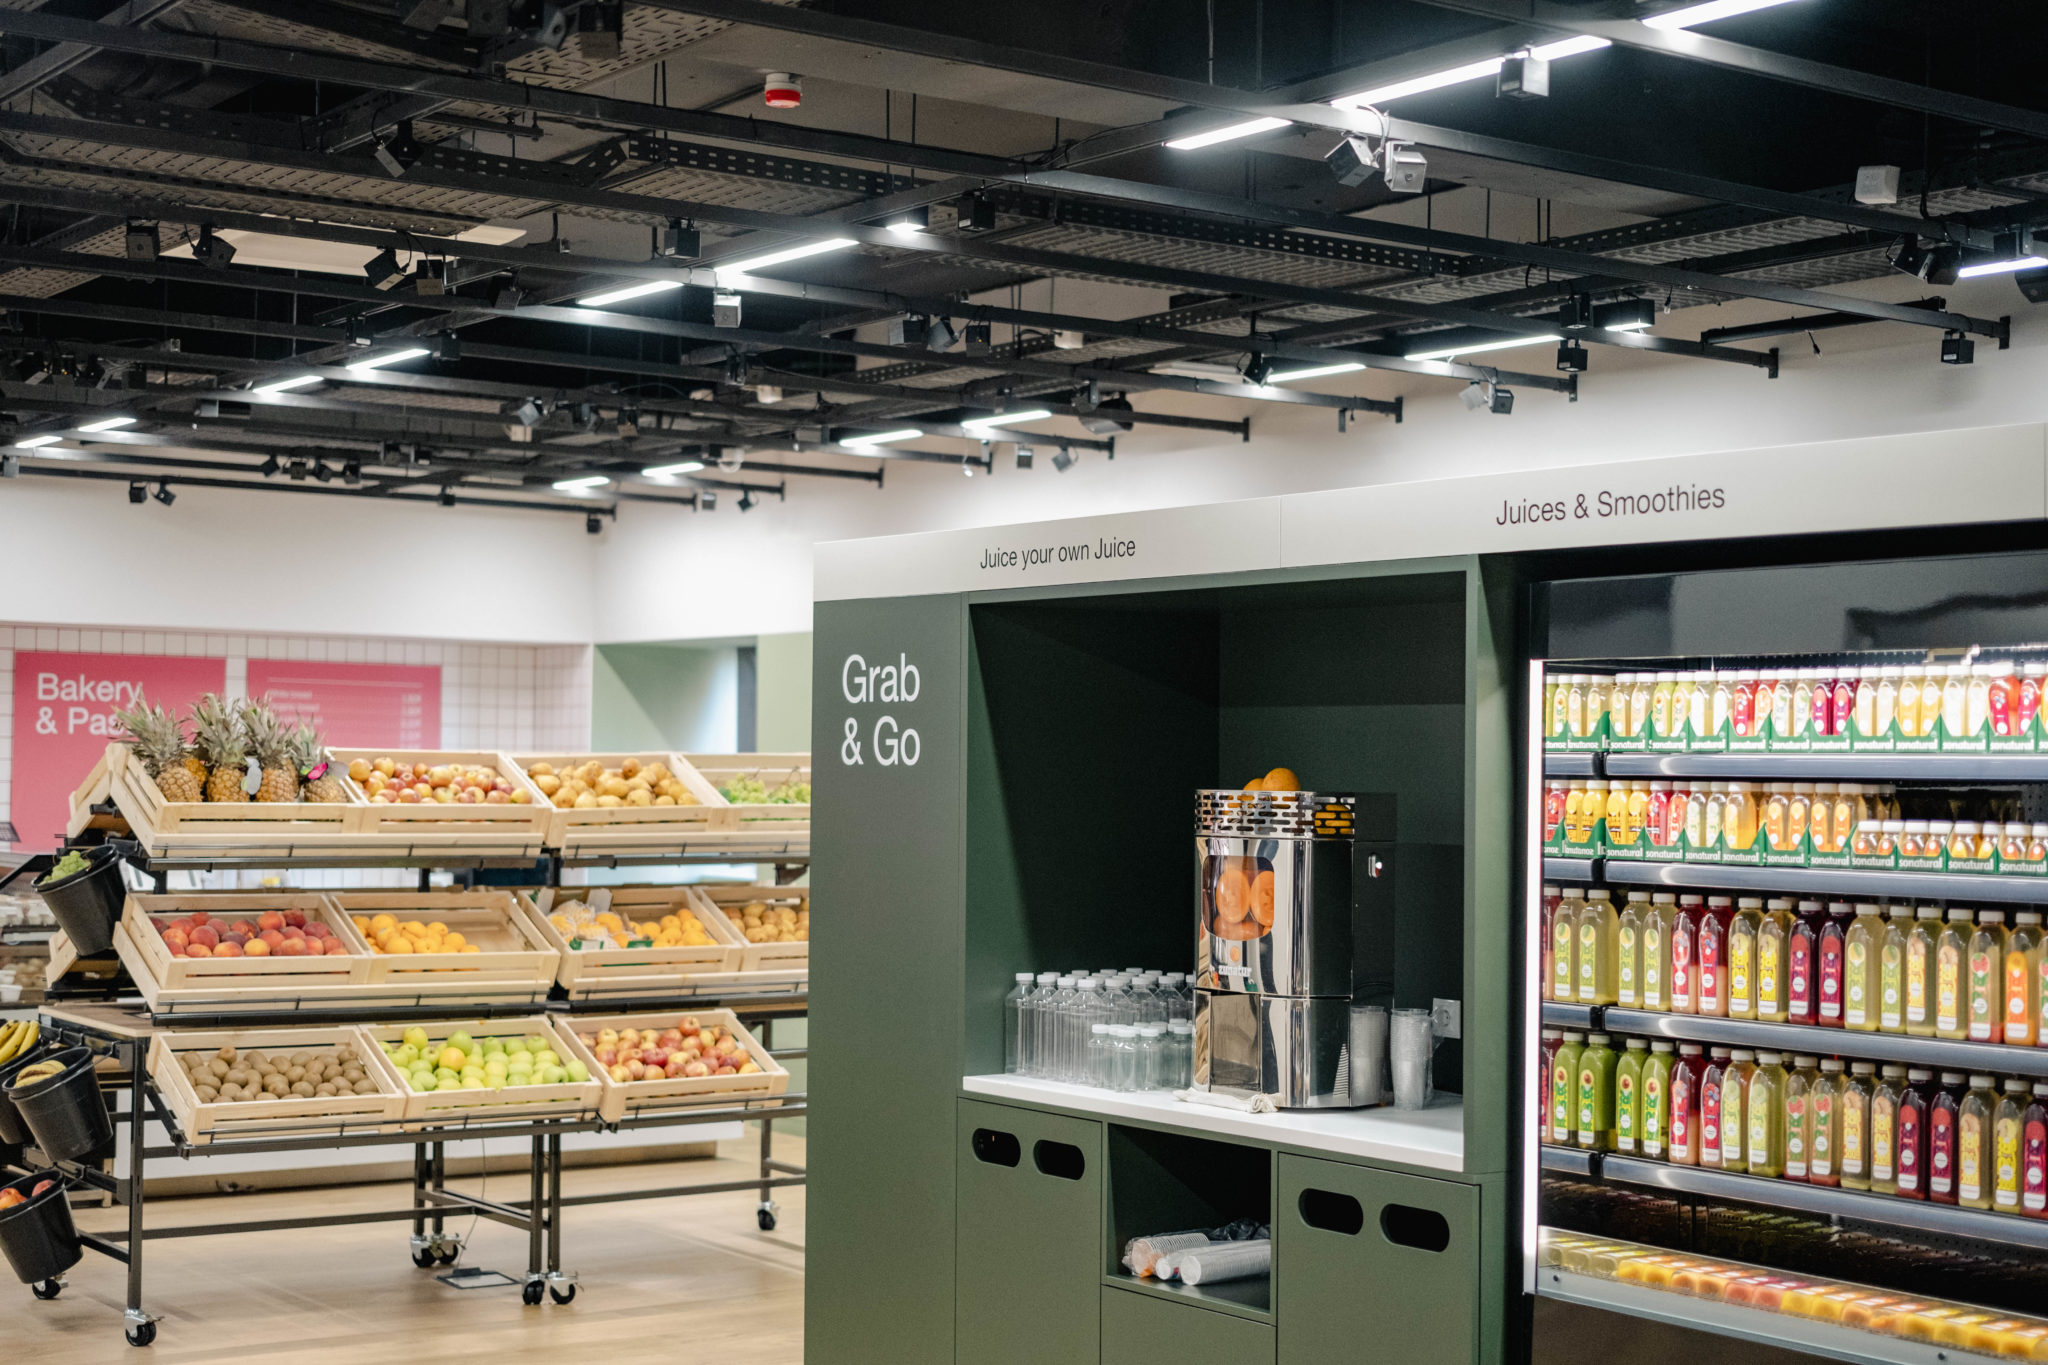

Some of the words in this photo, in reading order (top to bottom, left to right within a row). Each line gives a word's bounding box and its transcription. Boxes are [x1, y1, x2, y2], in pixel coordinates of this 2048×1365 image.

[1496, 498, 1566, 525] Juices
[1574, 493, 1590, 519] &
[1597, 483, 1725, 517] Smoothies
[980, 547, 1018, 569] Juice
[1021, 547, 1055, 571] your
[1058, 543, 1090, 562] own
[1094, 536, 1136, 560] Juice
[842, 652, 921, 704] Grab
[37, 672, 142, 709] Bakery
[35, 706, 58, 735] &
[841, 717, 864, 766] &
[873, 715, 921, 767] Go
[1606, 847, 1643, 857] sonatural
[1646, 848, 1683, 859] sonatural
[1685, 850, 1721, 861] sonatural
[1723, 851, 1759, 863] sonatural
[1767, 853, 1805, 864] sonatural
[1810, 855, 1850, 866] sonatural
[1852, 855, 1895, 867] sonatural
[1898, 856, 1943, 869] sonatural
[1948, 858, 1994, 871] sonatural
[1999, 860, 2047, 873] sonatural
